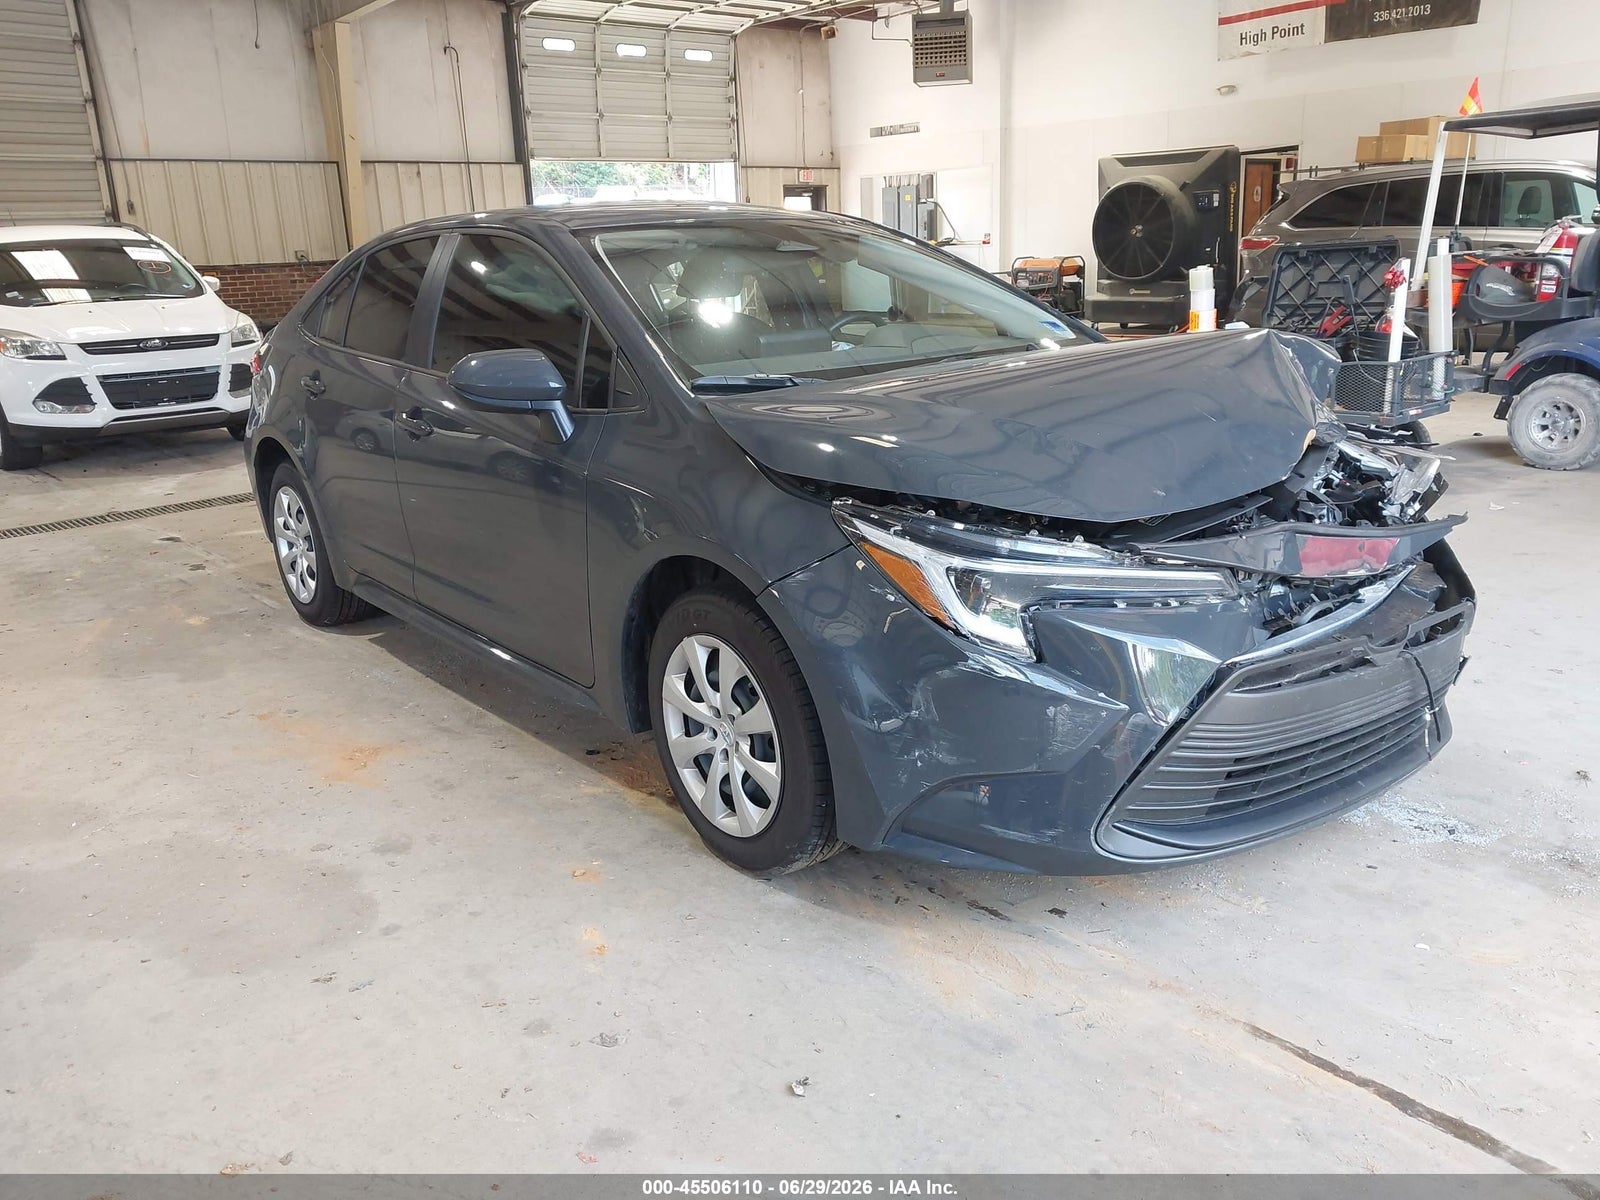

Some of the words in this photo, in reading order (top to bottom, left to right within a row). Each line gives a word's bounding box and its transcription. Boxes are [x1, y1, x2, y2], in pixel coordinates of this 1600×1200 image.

[1373, 4, 1431, 22] 336.421.2013
[1239, 28, 1267, 47] High
[1271, 23, 1305, 40] Point
